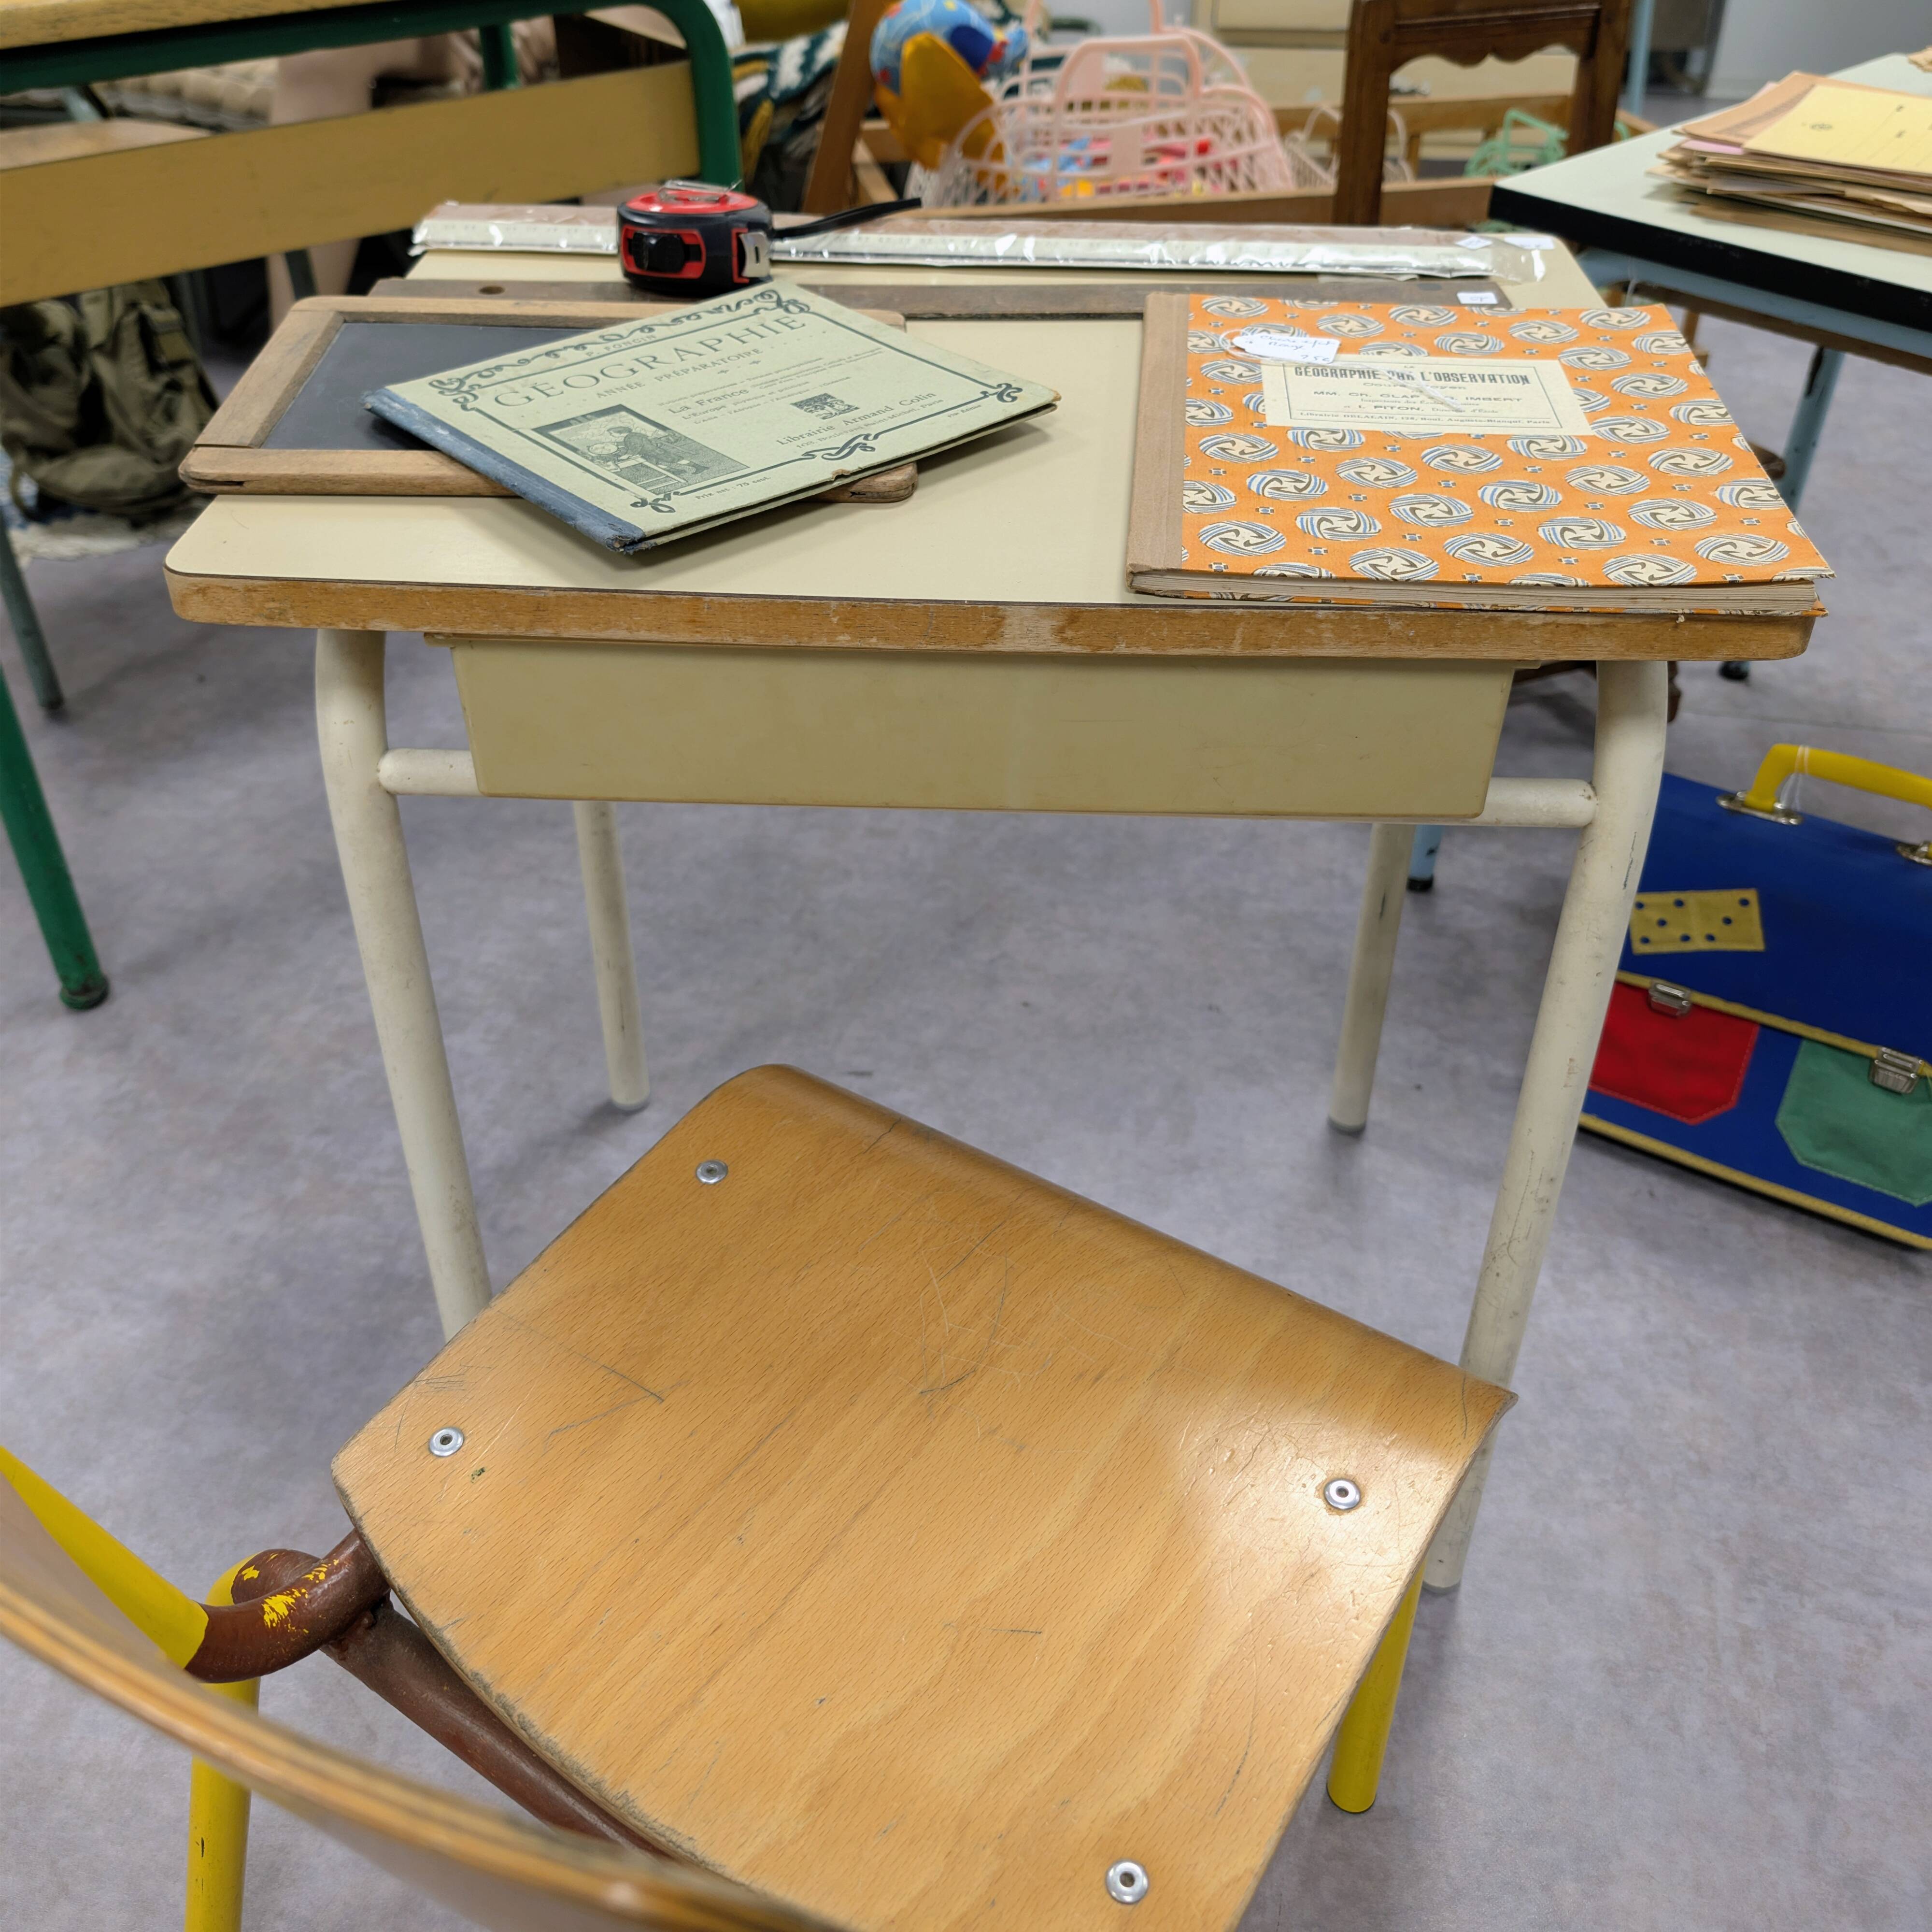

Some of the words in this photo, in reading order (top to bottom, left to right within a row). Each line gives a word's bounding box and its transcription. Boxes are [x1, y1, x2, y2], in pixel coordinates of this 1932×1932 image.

[495, 315, 806, 407] GÉOGRAPHIE
[596, 381, 646, 399] ANNÉE
[654, 348, 763, 382] PRÉPARATOIRE
[1294, 366, 1381, 380] GÉOGRAPHIE
[1420, 372, 1531, 386] L'OBSERVATION
[668, 405, 691, 414] La
[695, 389, 749, 406] France
[776, 424, 836, 445] Librairie
[842, 405, 894, 426] Armand
[899, 391, 937, 406] Colin
[922, 398, 944, 409] Paris
